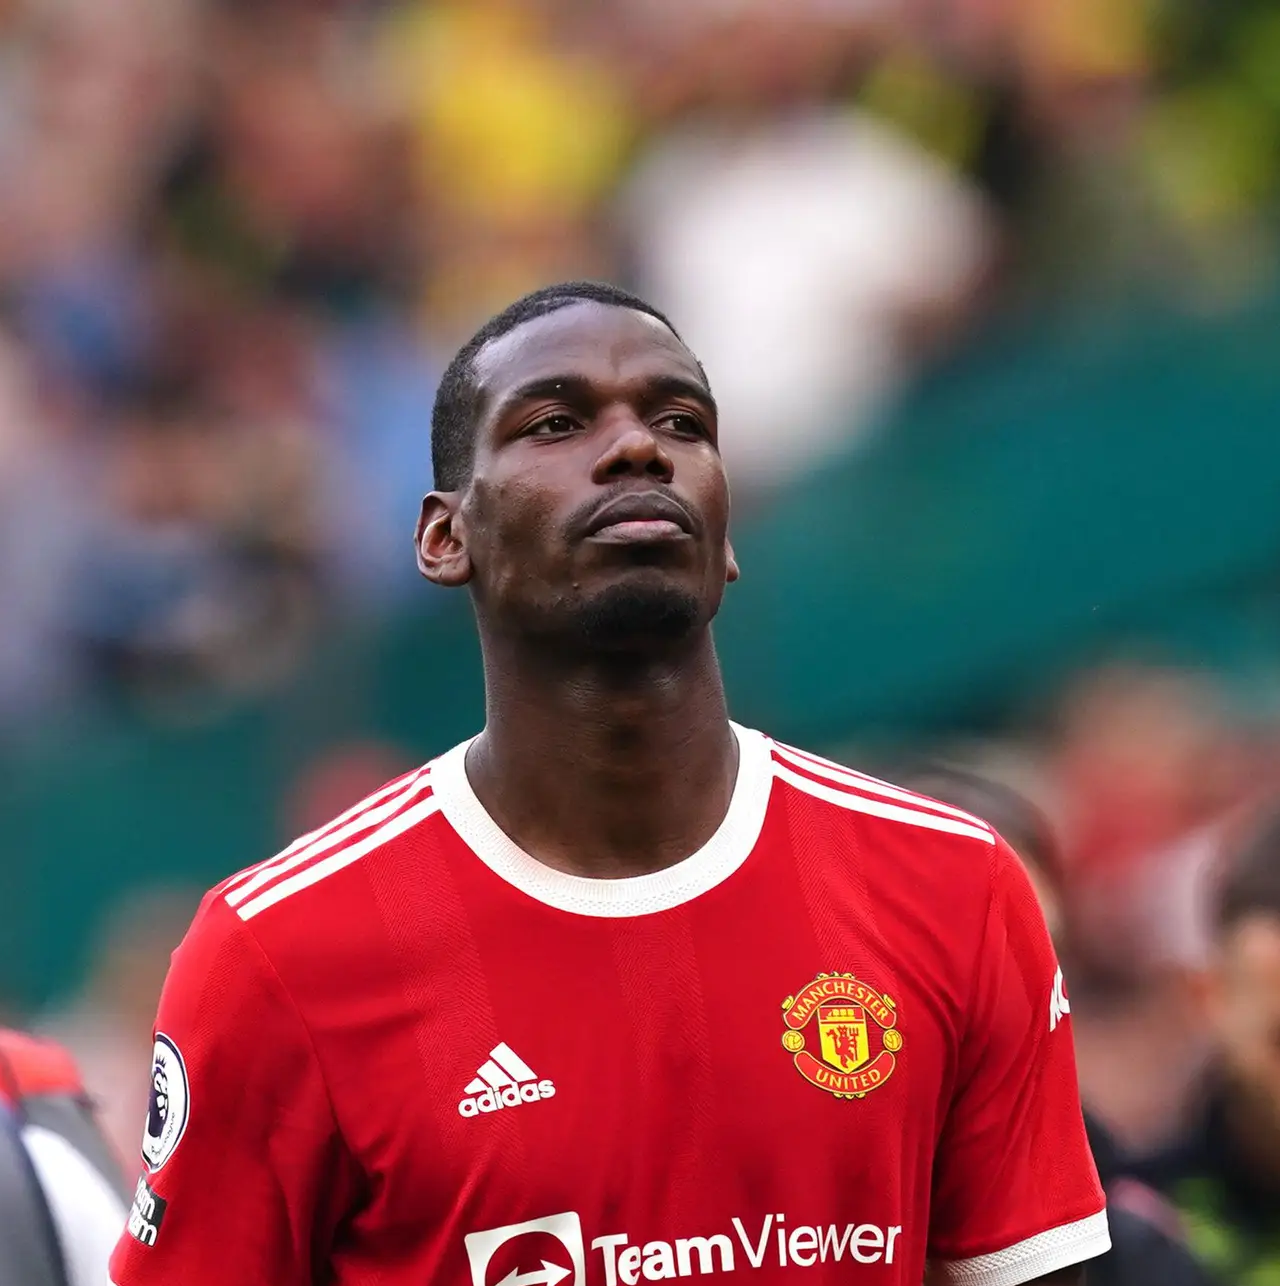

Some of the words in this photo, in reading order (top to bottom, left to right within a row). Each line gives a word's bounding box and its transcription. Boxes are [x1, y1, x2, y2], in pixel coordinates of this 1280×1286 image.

[792, 981, 889, 1021] MANCHESTER
[458, 1079, 556, 1118] adidas
[815, 1068, 881, 1090] UNITED
